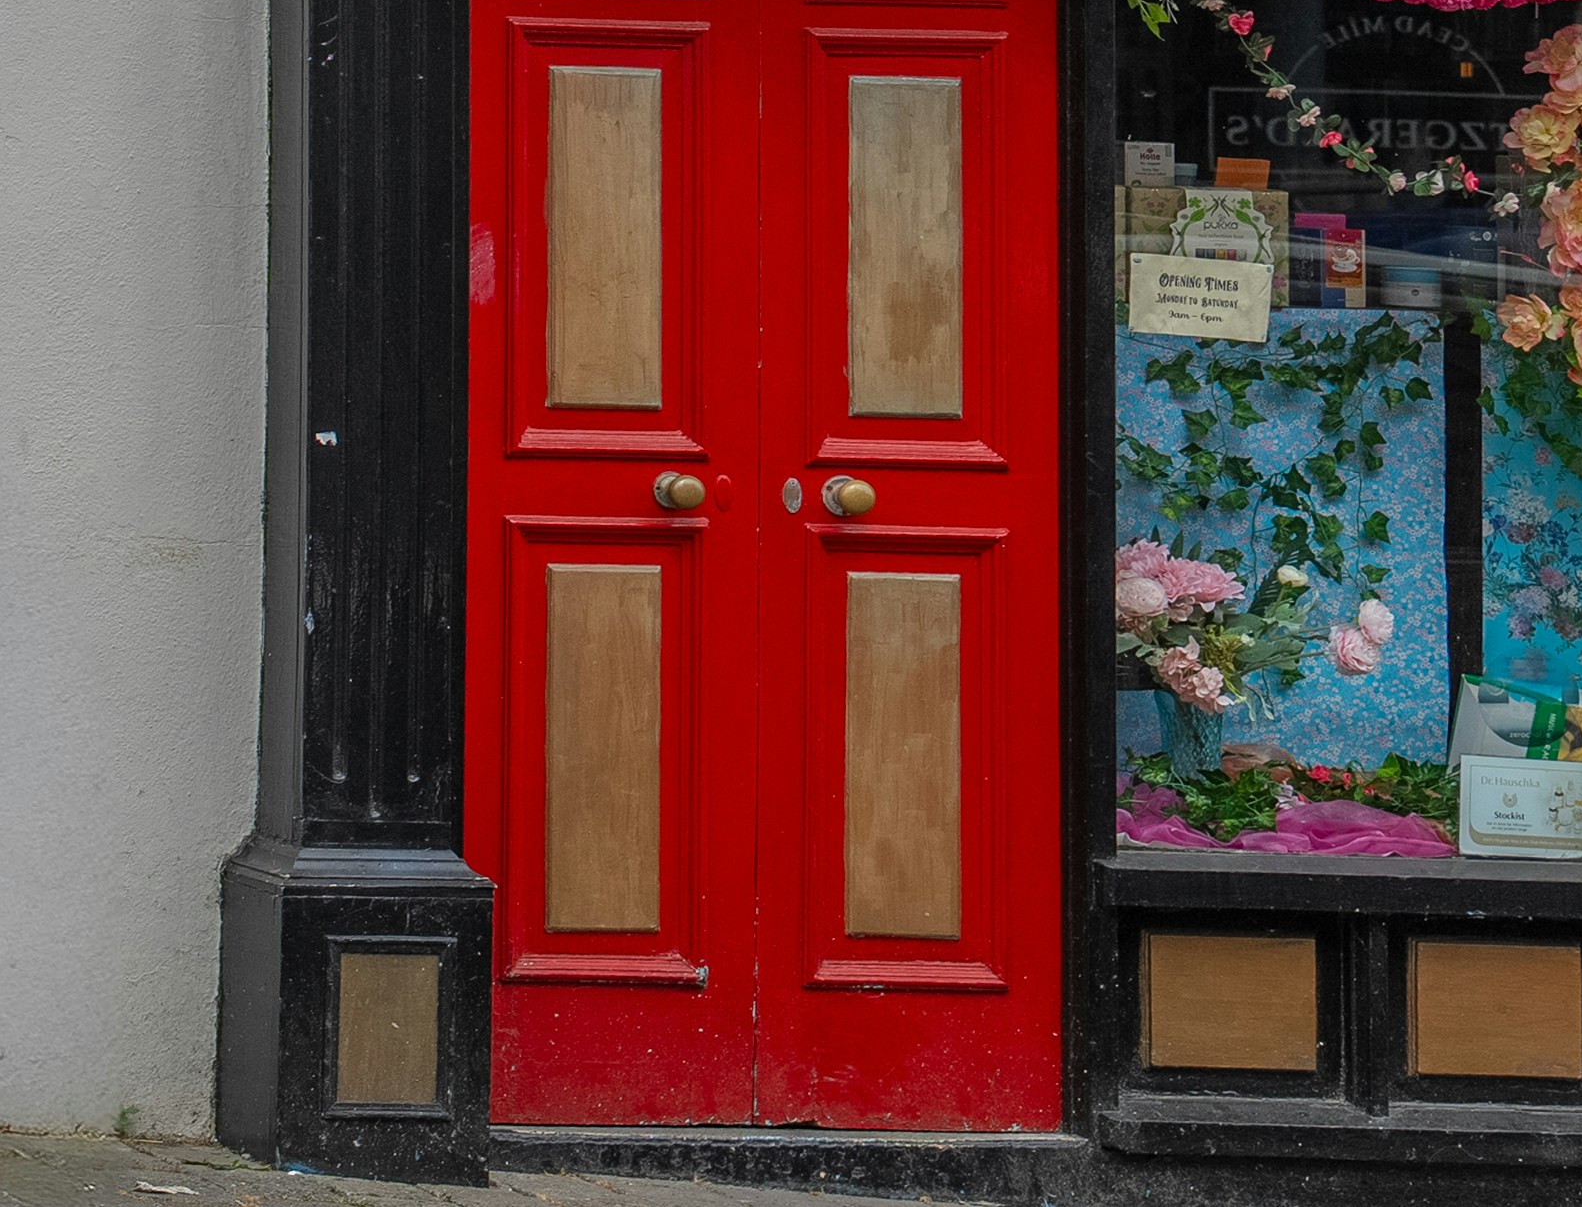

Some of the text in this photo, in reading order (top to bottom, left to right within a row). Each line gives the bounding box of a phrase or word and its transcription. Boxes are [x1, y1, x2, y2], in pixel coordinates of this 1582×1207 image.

[1139, 153, 1161, 161] Holle
[1203, 221, 1239, 231] pukka
[1159, 273, 1239, 292] OPENING TIMES
[1155, 293, 1239, 309] MONDAY TO SATURDAY
[1168, 310, 1190, 319] 9am
[1200, 312, 1223, 323] 6pm
[1494, 811, 1526, 821] Stockist
